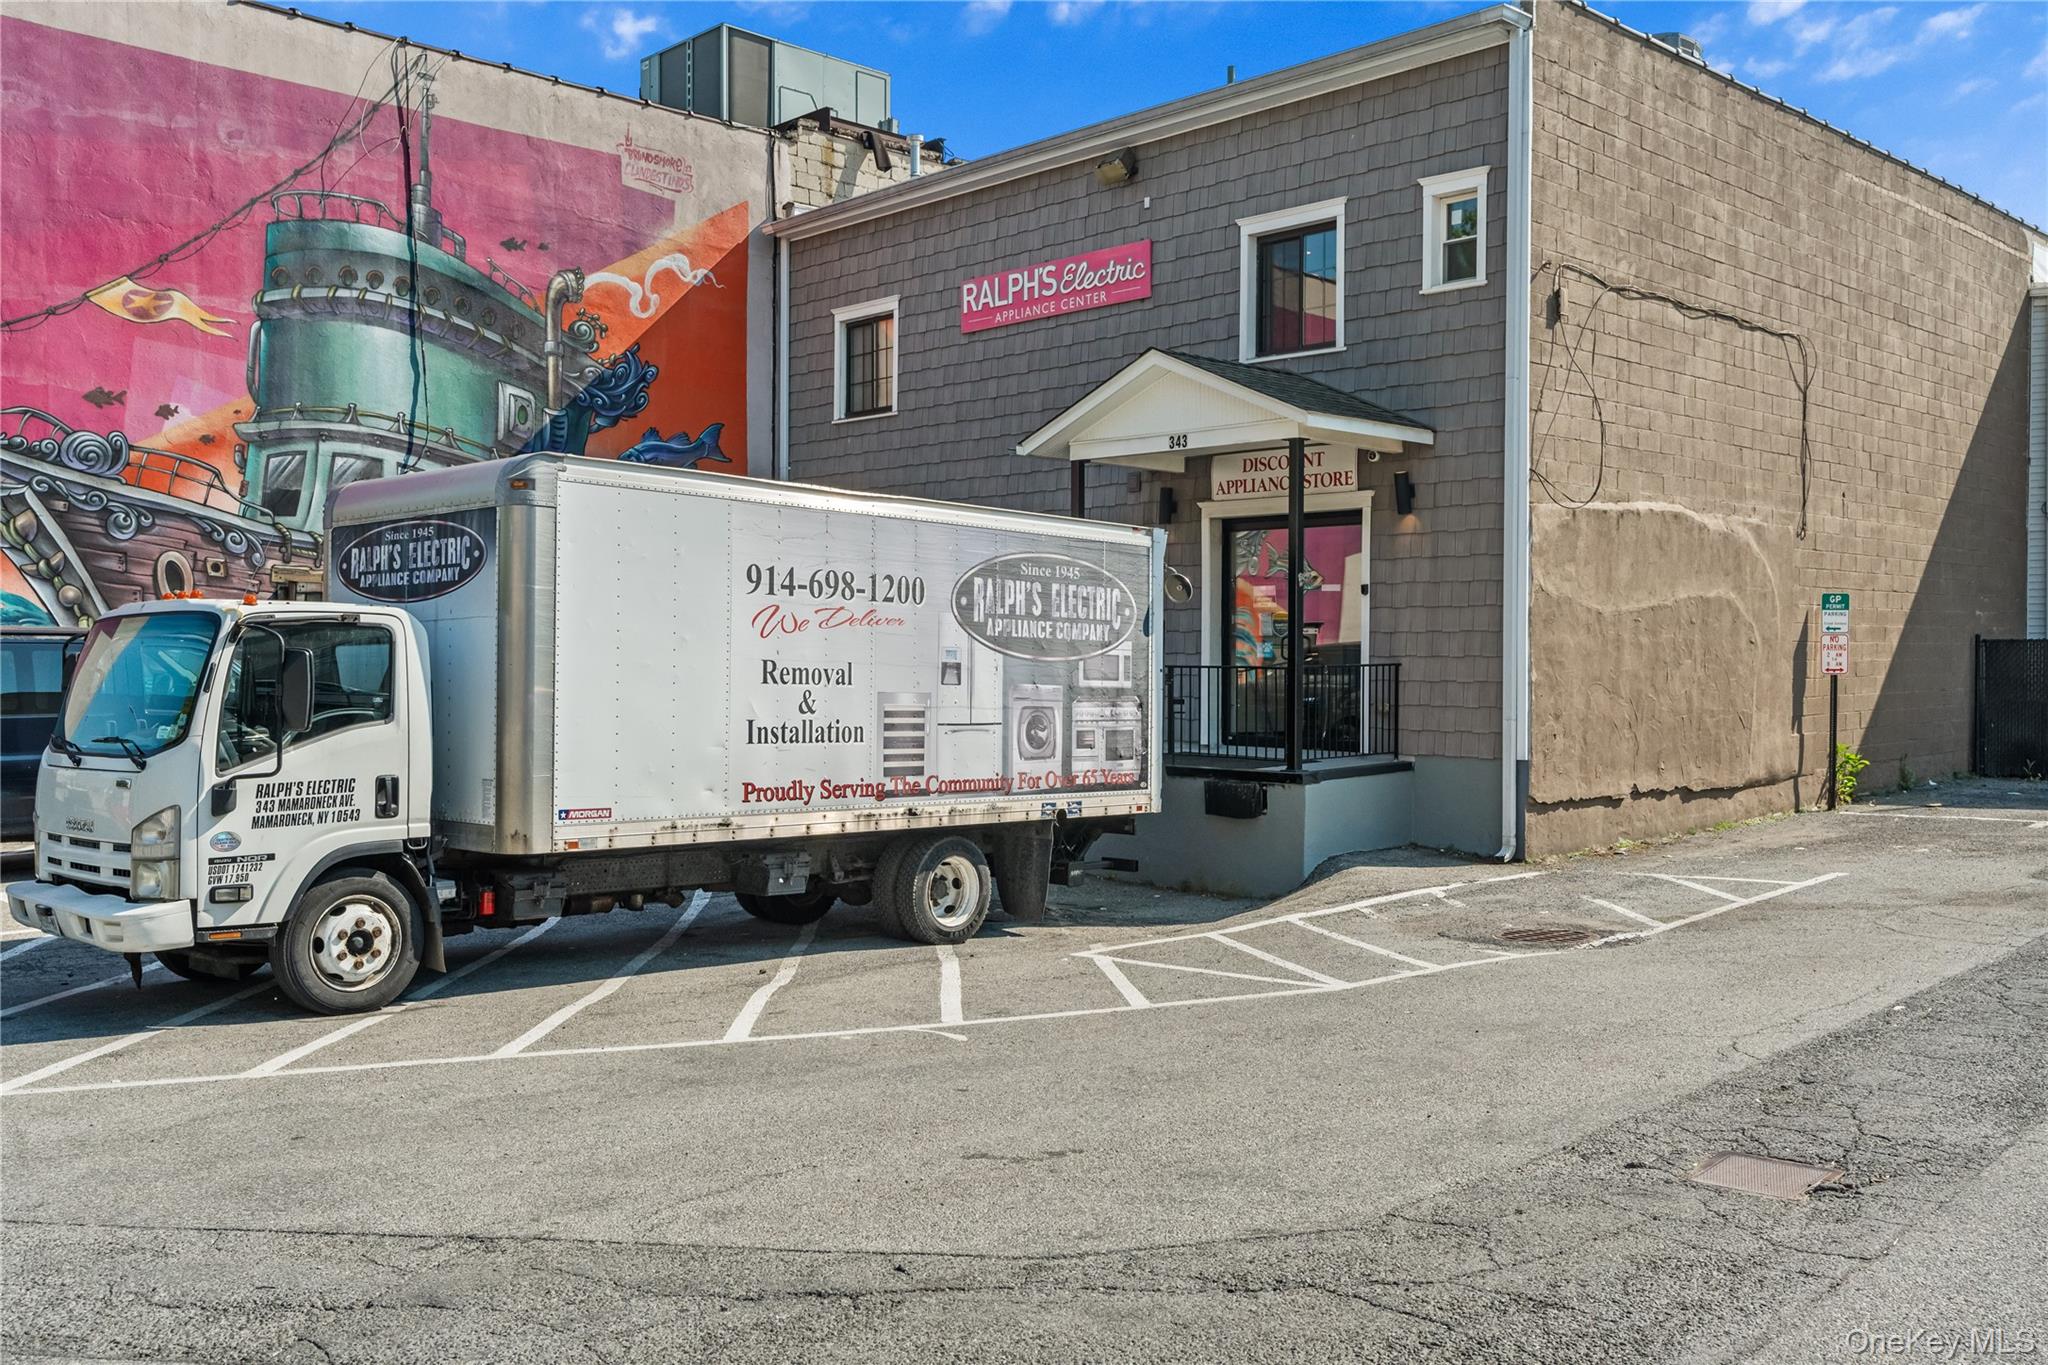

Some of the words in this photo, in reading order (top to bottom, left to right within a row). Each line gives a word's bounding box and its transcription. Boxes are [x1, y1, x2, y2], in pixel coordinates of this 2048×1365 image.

[962, 265, 1057, 314] RALPH'S
[1060, 257, 1146, 295] Electric
[994, 301, 1056, 324] APPLIANCE
[1060, 291, 1107, 311] CENTER
[1168, 434, 1188, 450] 343
[1242, 451, 1325, 474] DISCONT
[1215, 475, 1291, 497] APPLIANC
[1303, 470, 1355, 489] STORE
[384, 530, 409, 541] Since
[412, 526, 434, 538] 1945
[350, 543, 401, 580] RALPH'S
[408, 535, 471, 570] ELECTRIC
[359, 571, 410, 588] APPLIANCE
[412, 566, 460, 585] COMPANY
[1020, 562, 1051, 577] Since
[1055, 565, 1081, 580] 1945
[745, 563, 926, 606] 914-698-1200
[973, 576, 1042, 623] RALPH'S
[1051, 582, 1121, 630] ELECTRIC
[1829, 595, 1841, 603] GP
[751, 604, 810, 639] We
[814, 606, 906, 630] Deliver
[986, 617, 1052, 639] APPLIANCE
[1055, 621, 1110, 642] COMPANY
[1823, 644, 1847, 652] PARKING
[760, 659, 853, 686] Removal
[798, 689, 817, 715] &
[745, 718, 865, 745] Installation
[255, 781, 304, 799] RALPH'S
[306, 778, 356, 796] ELECTRIC
[741, 779, 816, 806] Proudly
[819, 777, 887, 801] Serving
[889, 775, 922, 795] The
[925, 772, 1015, 796] Community
[1017, 771, 1043, 790] For
[1044, 769, 1080, 789] Over
[1082, 769, 1098, 786] 65
[1100, 768, 1136, 785] Years
[255, 799, 275, 813] 343
[277, 794, 338, 812] MAMARONECK
[338, 794, 356, 808] AVE.
[567, 810, 610, 819] MORGAN
[251, 812, 315, 829] MAMARONECK,
[317, 811, 329, 825] NY
[331, 808, 361, 823] 10543
[207, 864, 230, 876] USDOT
[231, 862, 263, 874] 1741232
[207, 875, 223, 885] GVW
